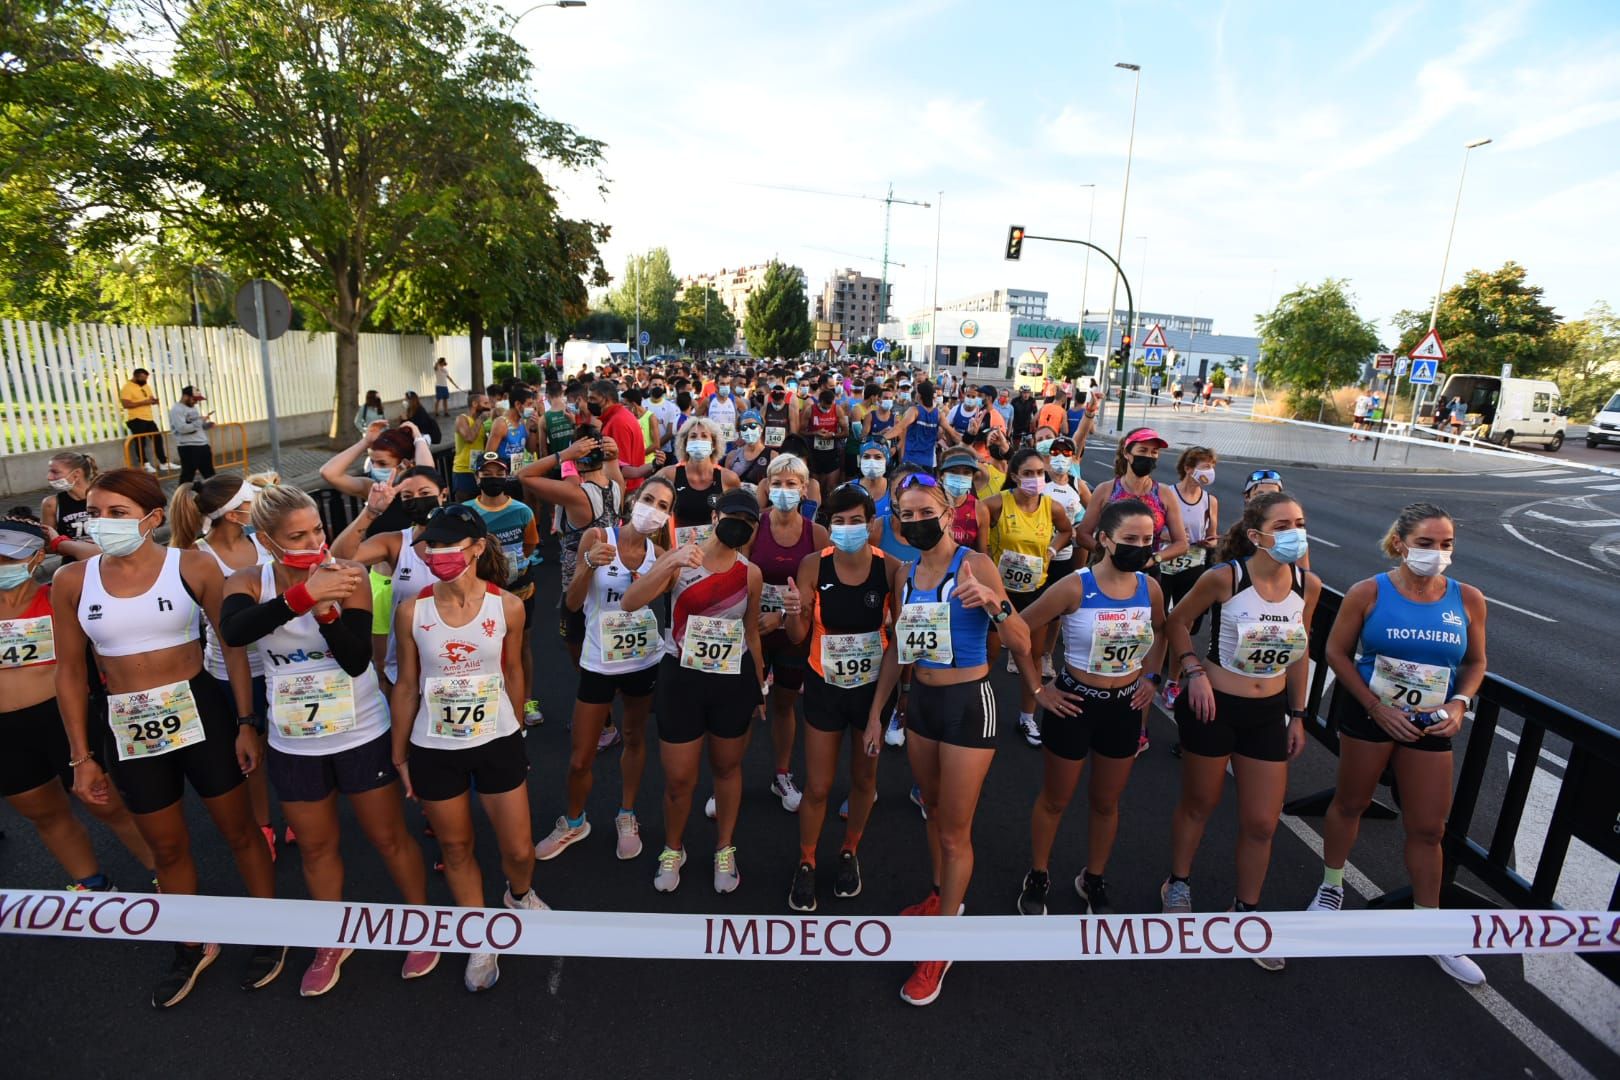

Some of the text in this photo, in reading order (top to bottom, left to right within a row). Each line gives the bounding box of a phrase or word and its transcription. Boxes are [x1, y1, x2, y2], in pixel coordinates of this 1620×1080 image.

[1004, 568, 1033, 584] 508
[1098, 613, 1126, 621] BIMBO
[613, 632, 648, 650] 295
[906, 631, 938, 649] 443
[1386, 628, 1461, 645] TROTASIERRA
[0, 644, 38, 664] 42
[695, 642, 733, 660] 307
[1103, 645, 1139, 662] 507
[1247, 649, 1291, 665] 486
[835, 659, 872, 676] 198
[1074, 686, 1111, 699] PRO
[1391, 684, 1422, 706] 70
[304, 703, 319, 722] 7
[443, 704, 485, 724] 176
[128, 715, 181, 741] 289
[337, 907, 522, 949] IMDECO
[704, 917, 891, 956] IMDECO
[1080, 915, 1273, 956] IMDECO
